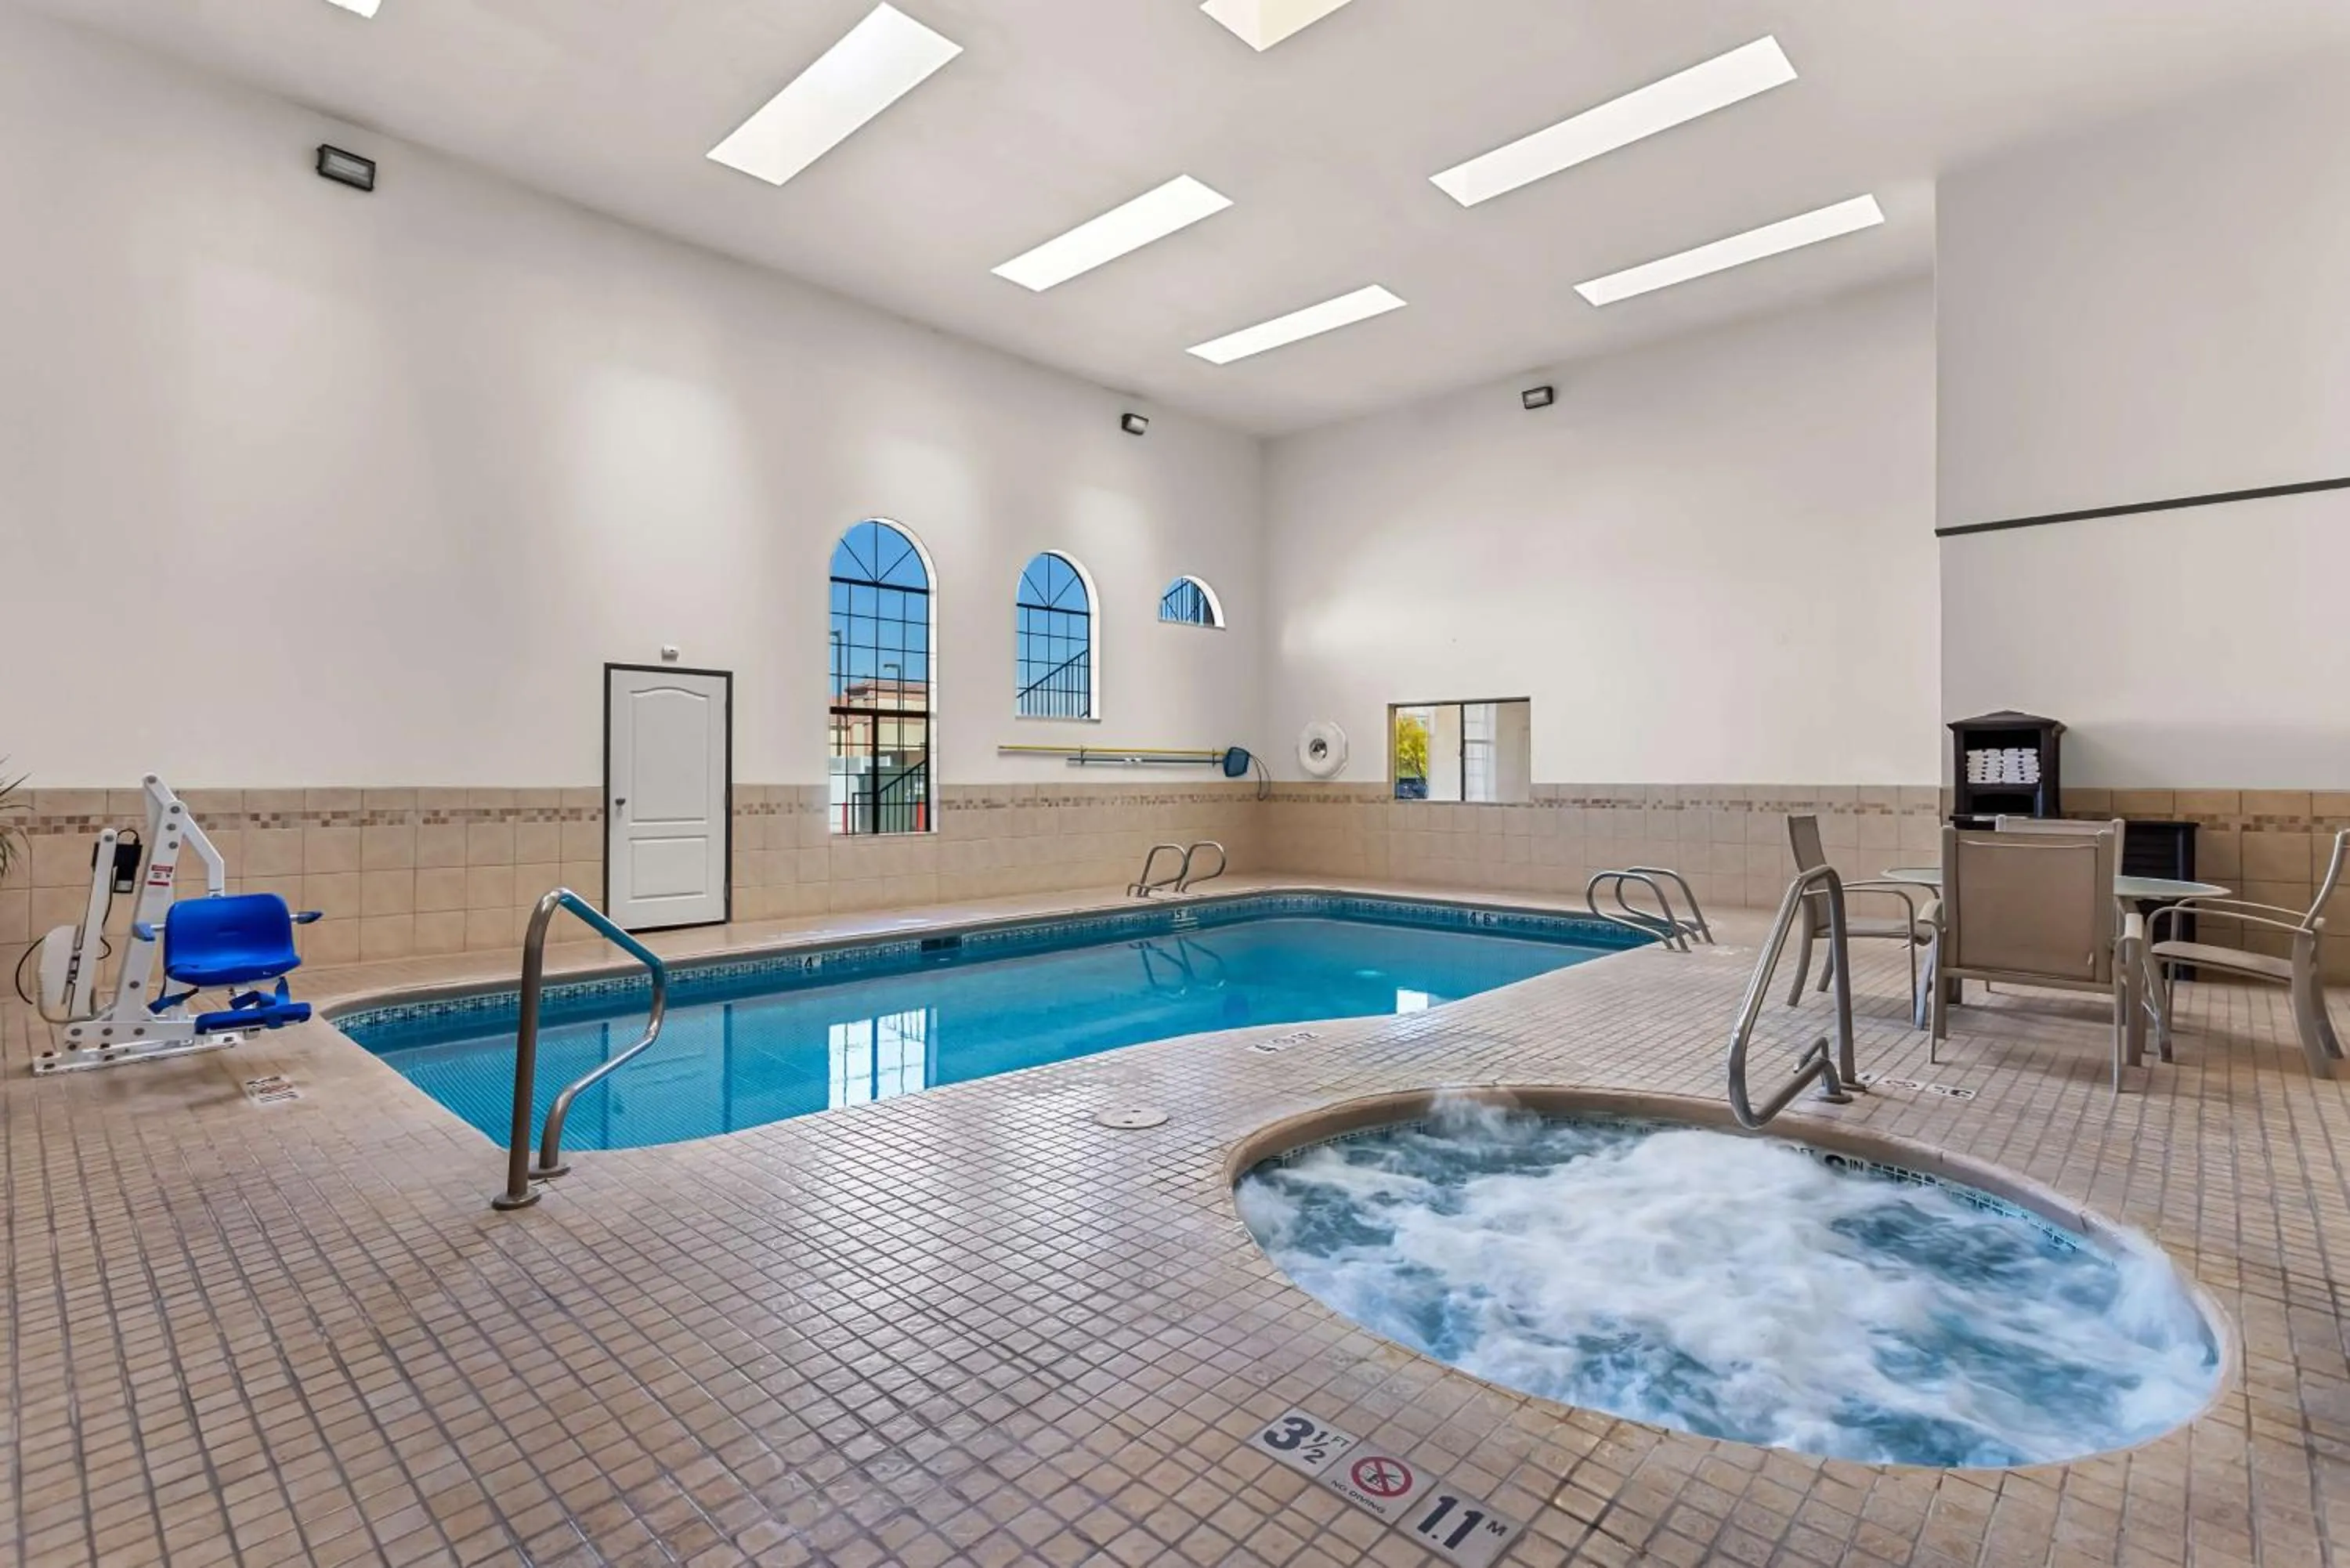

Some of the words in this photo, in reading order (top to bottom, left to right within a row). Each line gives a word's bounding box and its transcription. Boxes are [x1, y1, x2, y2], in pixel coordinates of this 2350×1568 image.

[804, 956, 813, 967] 4
[1849, 1158, 1864, 1172] IN
[1264, 1417, 1315, 1451] 3
[1331, 1436, 1350, 1448] FT
[1332, 1479, 1348, 1492] NO
[1349, 1490, 1386, 1514] DIVING
[1416, 1495, 1484, 1550] 1.1
[1486, 1519, 1508, 1537] M
